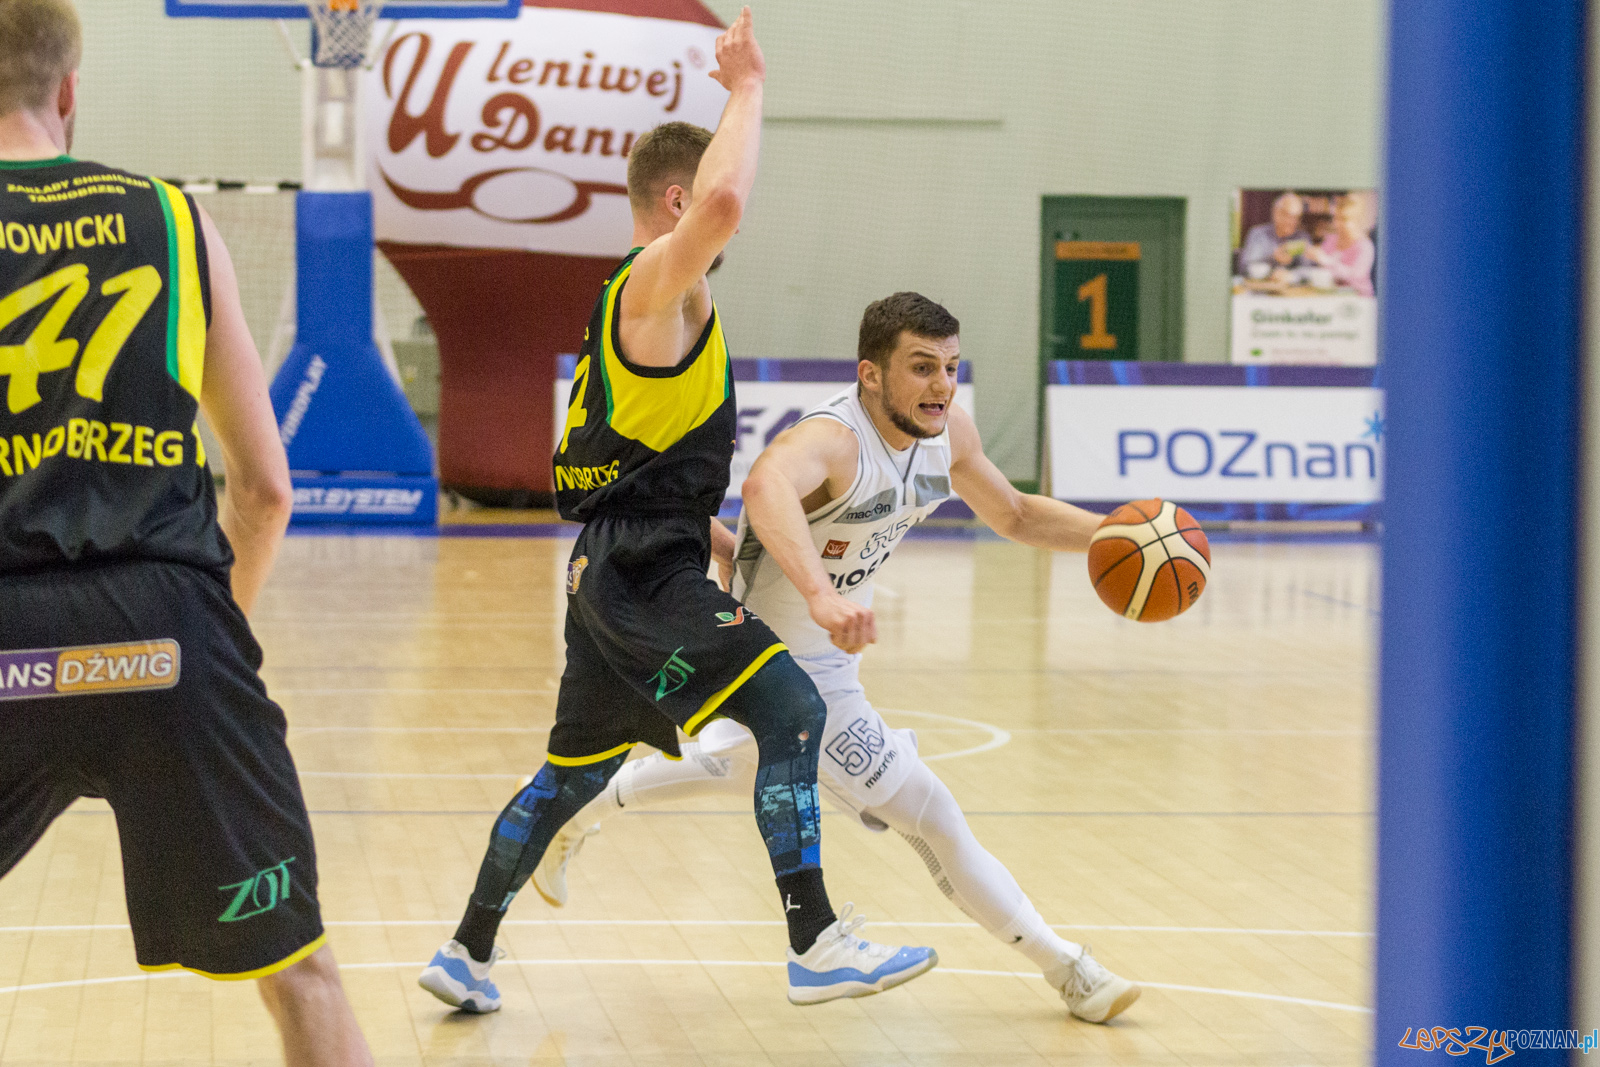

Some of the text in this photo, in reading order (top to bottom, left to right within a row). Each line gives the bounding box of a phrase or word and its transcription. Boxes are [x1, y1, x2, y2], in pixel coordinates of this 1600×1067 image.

[382, 32, 683, 158] U leniwej
[0, 213, 127, 254] OWICKI
[0, 264, 162, 414] 41
[1078, 273, 1117, 349] 1
[0, 662, 53, 690] NS
[824, 717, 885, 777] 55
